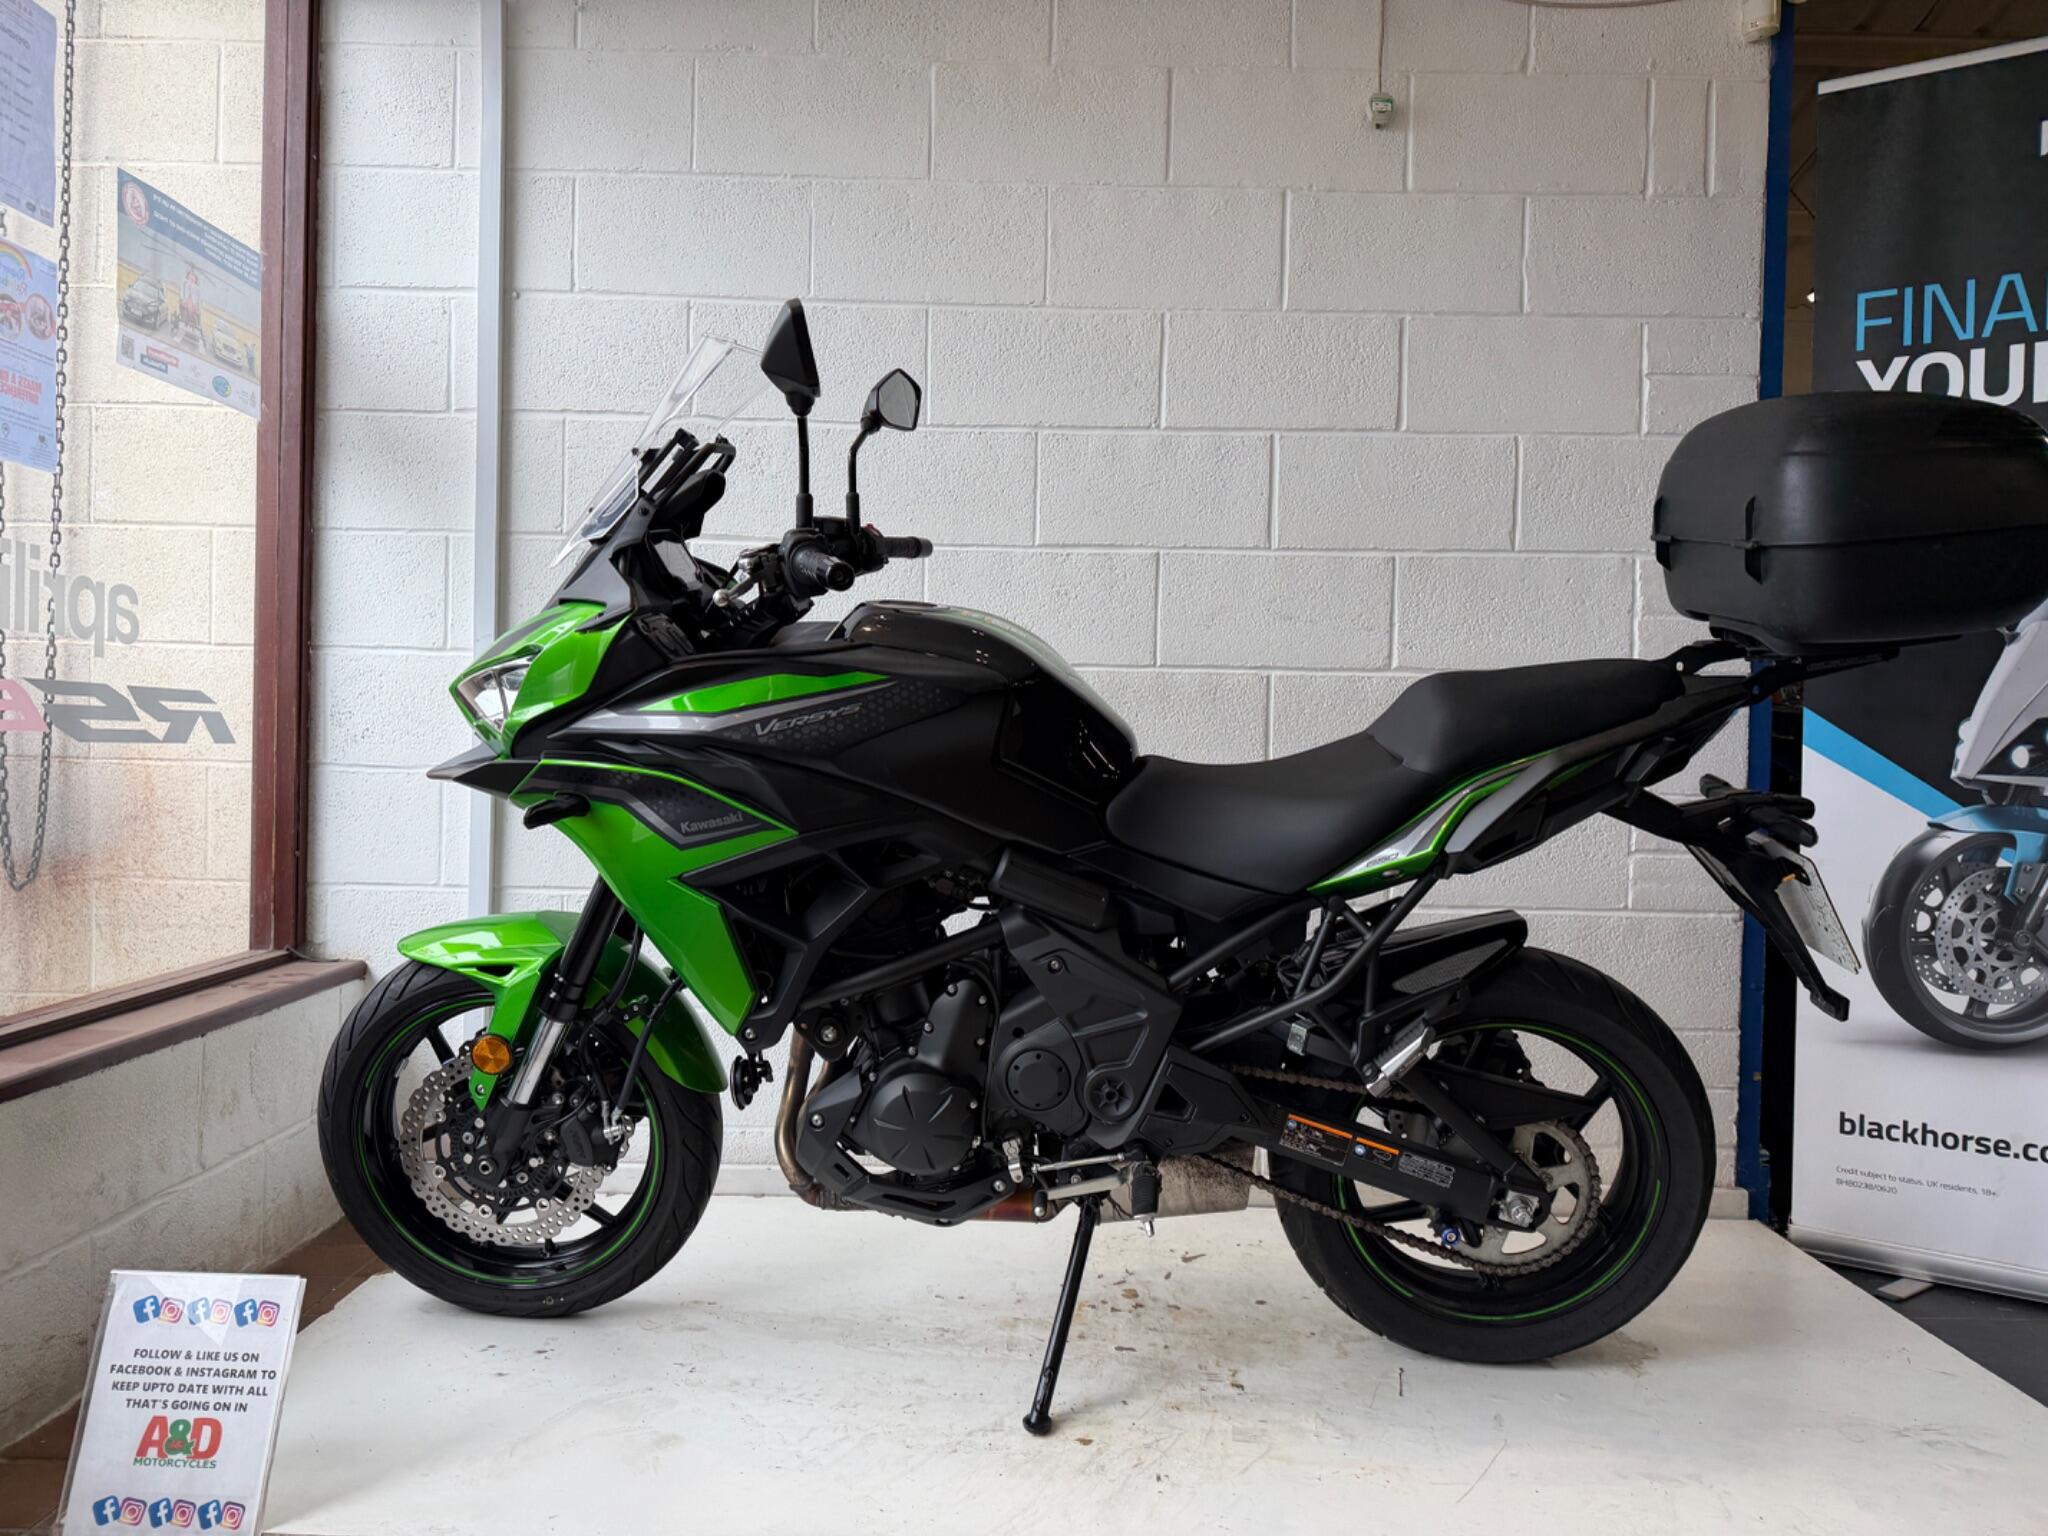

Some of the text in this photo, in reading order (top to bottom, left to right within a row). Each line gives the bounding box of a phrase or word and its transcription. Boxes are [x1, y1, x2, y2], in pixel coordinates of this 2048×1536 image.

[1856, 273, 2048, 351] FINA
[1856, 341, 2048, 407] YOU
[680, 811, 744, 834] Kawasaki
[1836, 1165, 1858, 1175] Credit
[1860, 1170, 1887, 1180] subject
[1888, 1174, 1897, 1182] to
[1926, 1180, 1938, 1188] UK
[133, 1348, 260, 1363] FOLLOW & LIKE US ON
[110, 1364, 276, 1380] FACEBOOK & INSTAGRAM TO
[111, 1381, 268, 1397] KEEP UPTO DATE WITH ALL
[125, 1398, 248, 1413] THAT'S GOING ON IN
[135, 1415, 223, 1460] A&D
[133, 1457, 217, 1469] MOTORCYCLES
